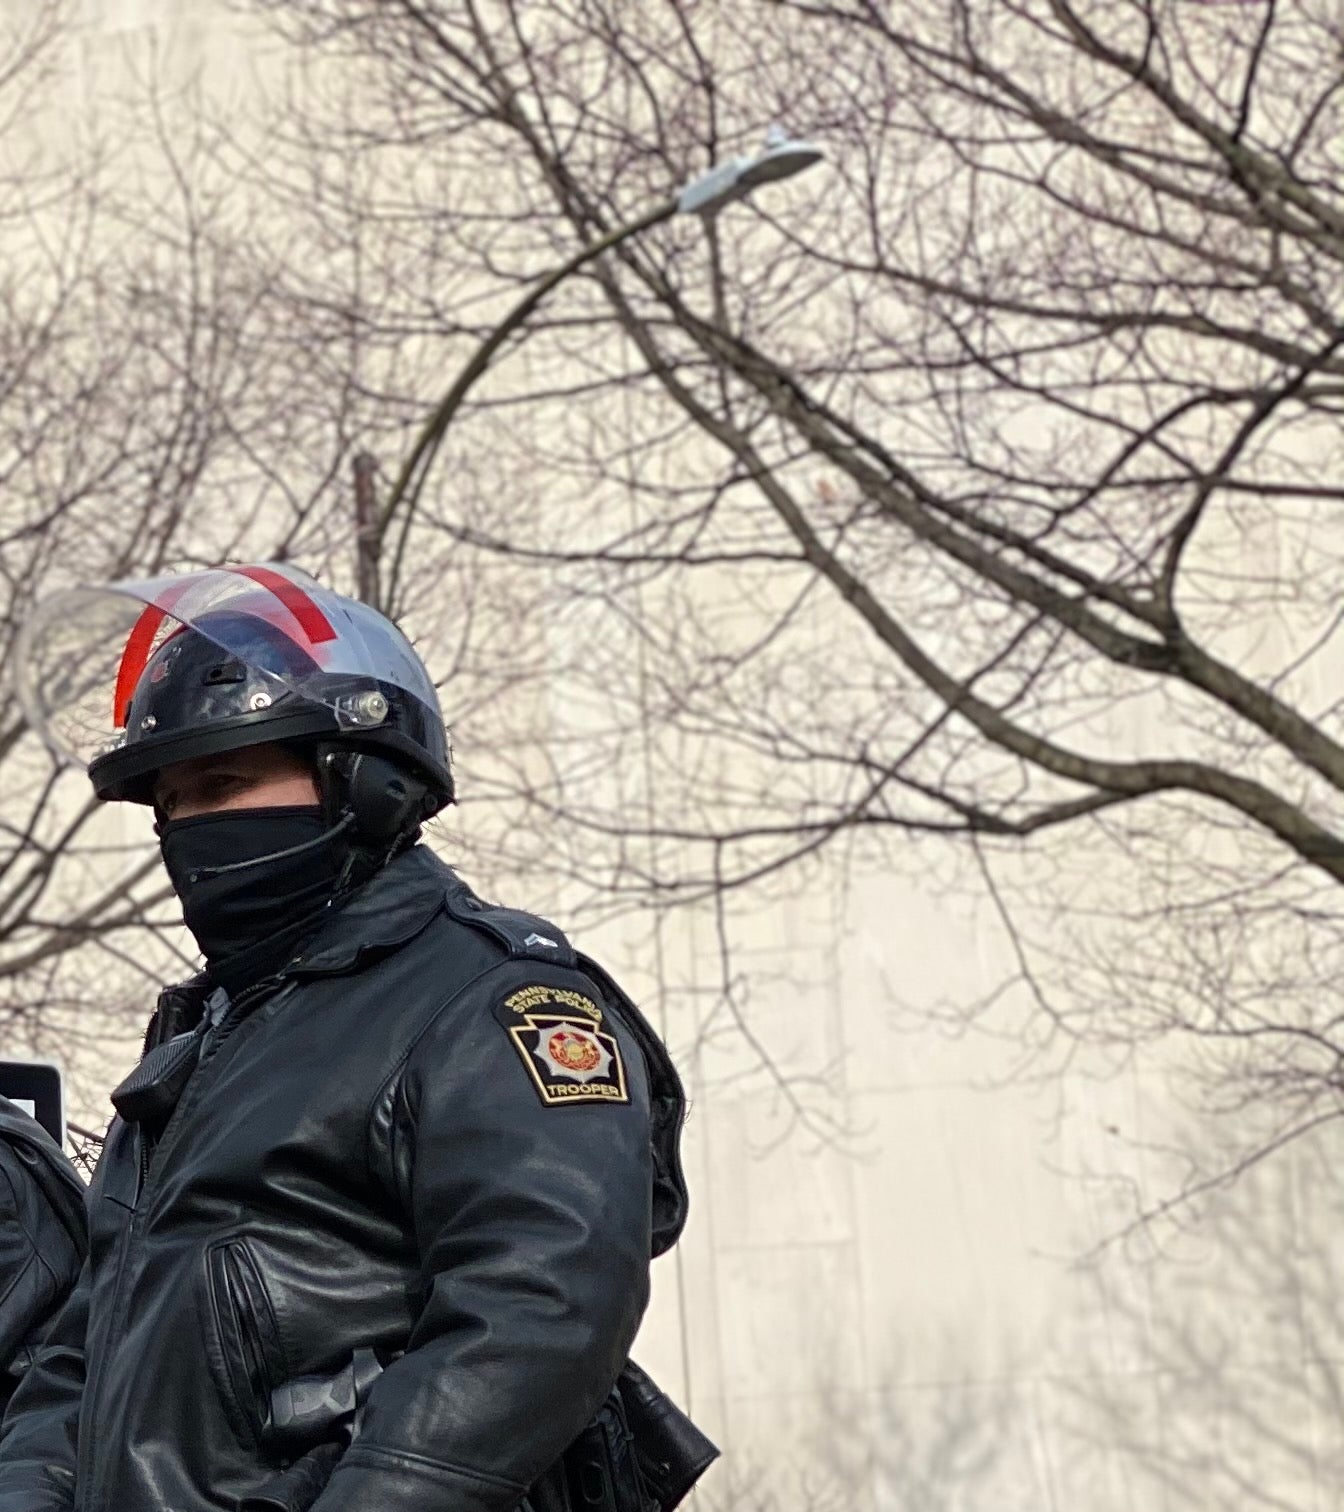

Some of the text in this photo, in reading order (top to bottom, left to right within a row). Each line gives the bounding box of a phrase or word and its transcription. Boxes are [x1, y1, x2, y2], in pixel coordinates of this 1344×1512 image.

[504, 985, 603, 1021] PENNSYLVANIA
[512, 994, 551, 1013] STATE
[546, 1084, 619, 1096] TROOPER
